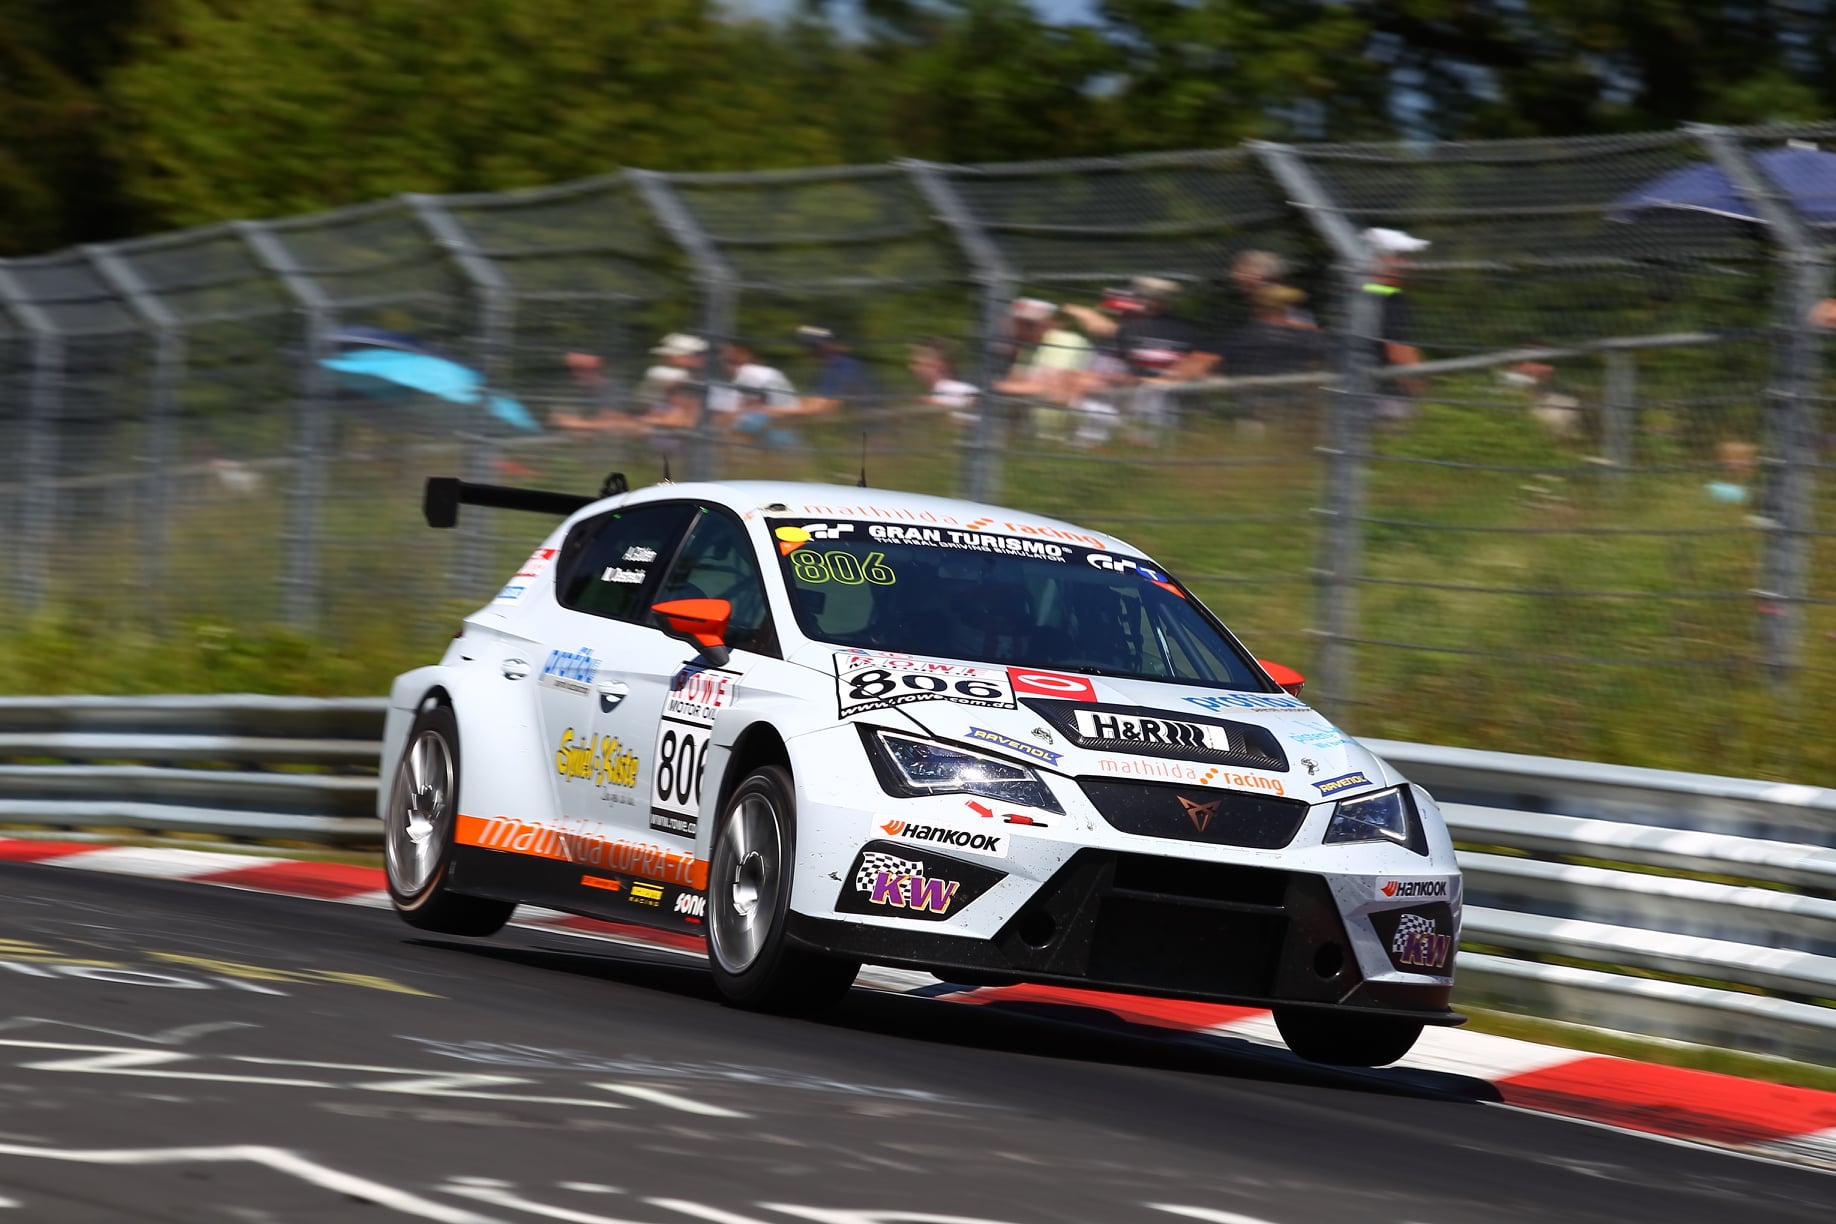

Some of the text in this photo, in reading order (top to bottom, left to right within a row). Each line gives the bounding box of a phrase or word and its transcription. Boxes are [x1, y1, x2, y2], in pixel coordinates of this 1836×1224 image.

[803, 504, 1107, 550] mathilda racing
[868, 525, 942, 542] GRAN
[873, 537, 1066, 563] THE REAL DRIVING SIMULATOR
[790, 549, 897, 585] 806
[851, 656, 985, 676] ROWE
[671, 671, 728, 707] ROWE
[849, 669, 1002, 700] 806
[667, 699, 718, 721] MOTOR OIL
[841, 691, 1016, 718] www.rowe.com.de
[974, 730, 1055, 760] RAVENOL
[1098, 758, 1285, 797] mathilda racing
[1318, 774, 1367, 794] RAVENOL
[478, 815, 606, 865] mathilda
[869, 870, 961, 914] KW
[1400, 931, 1452, 969] KW
